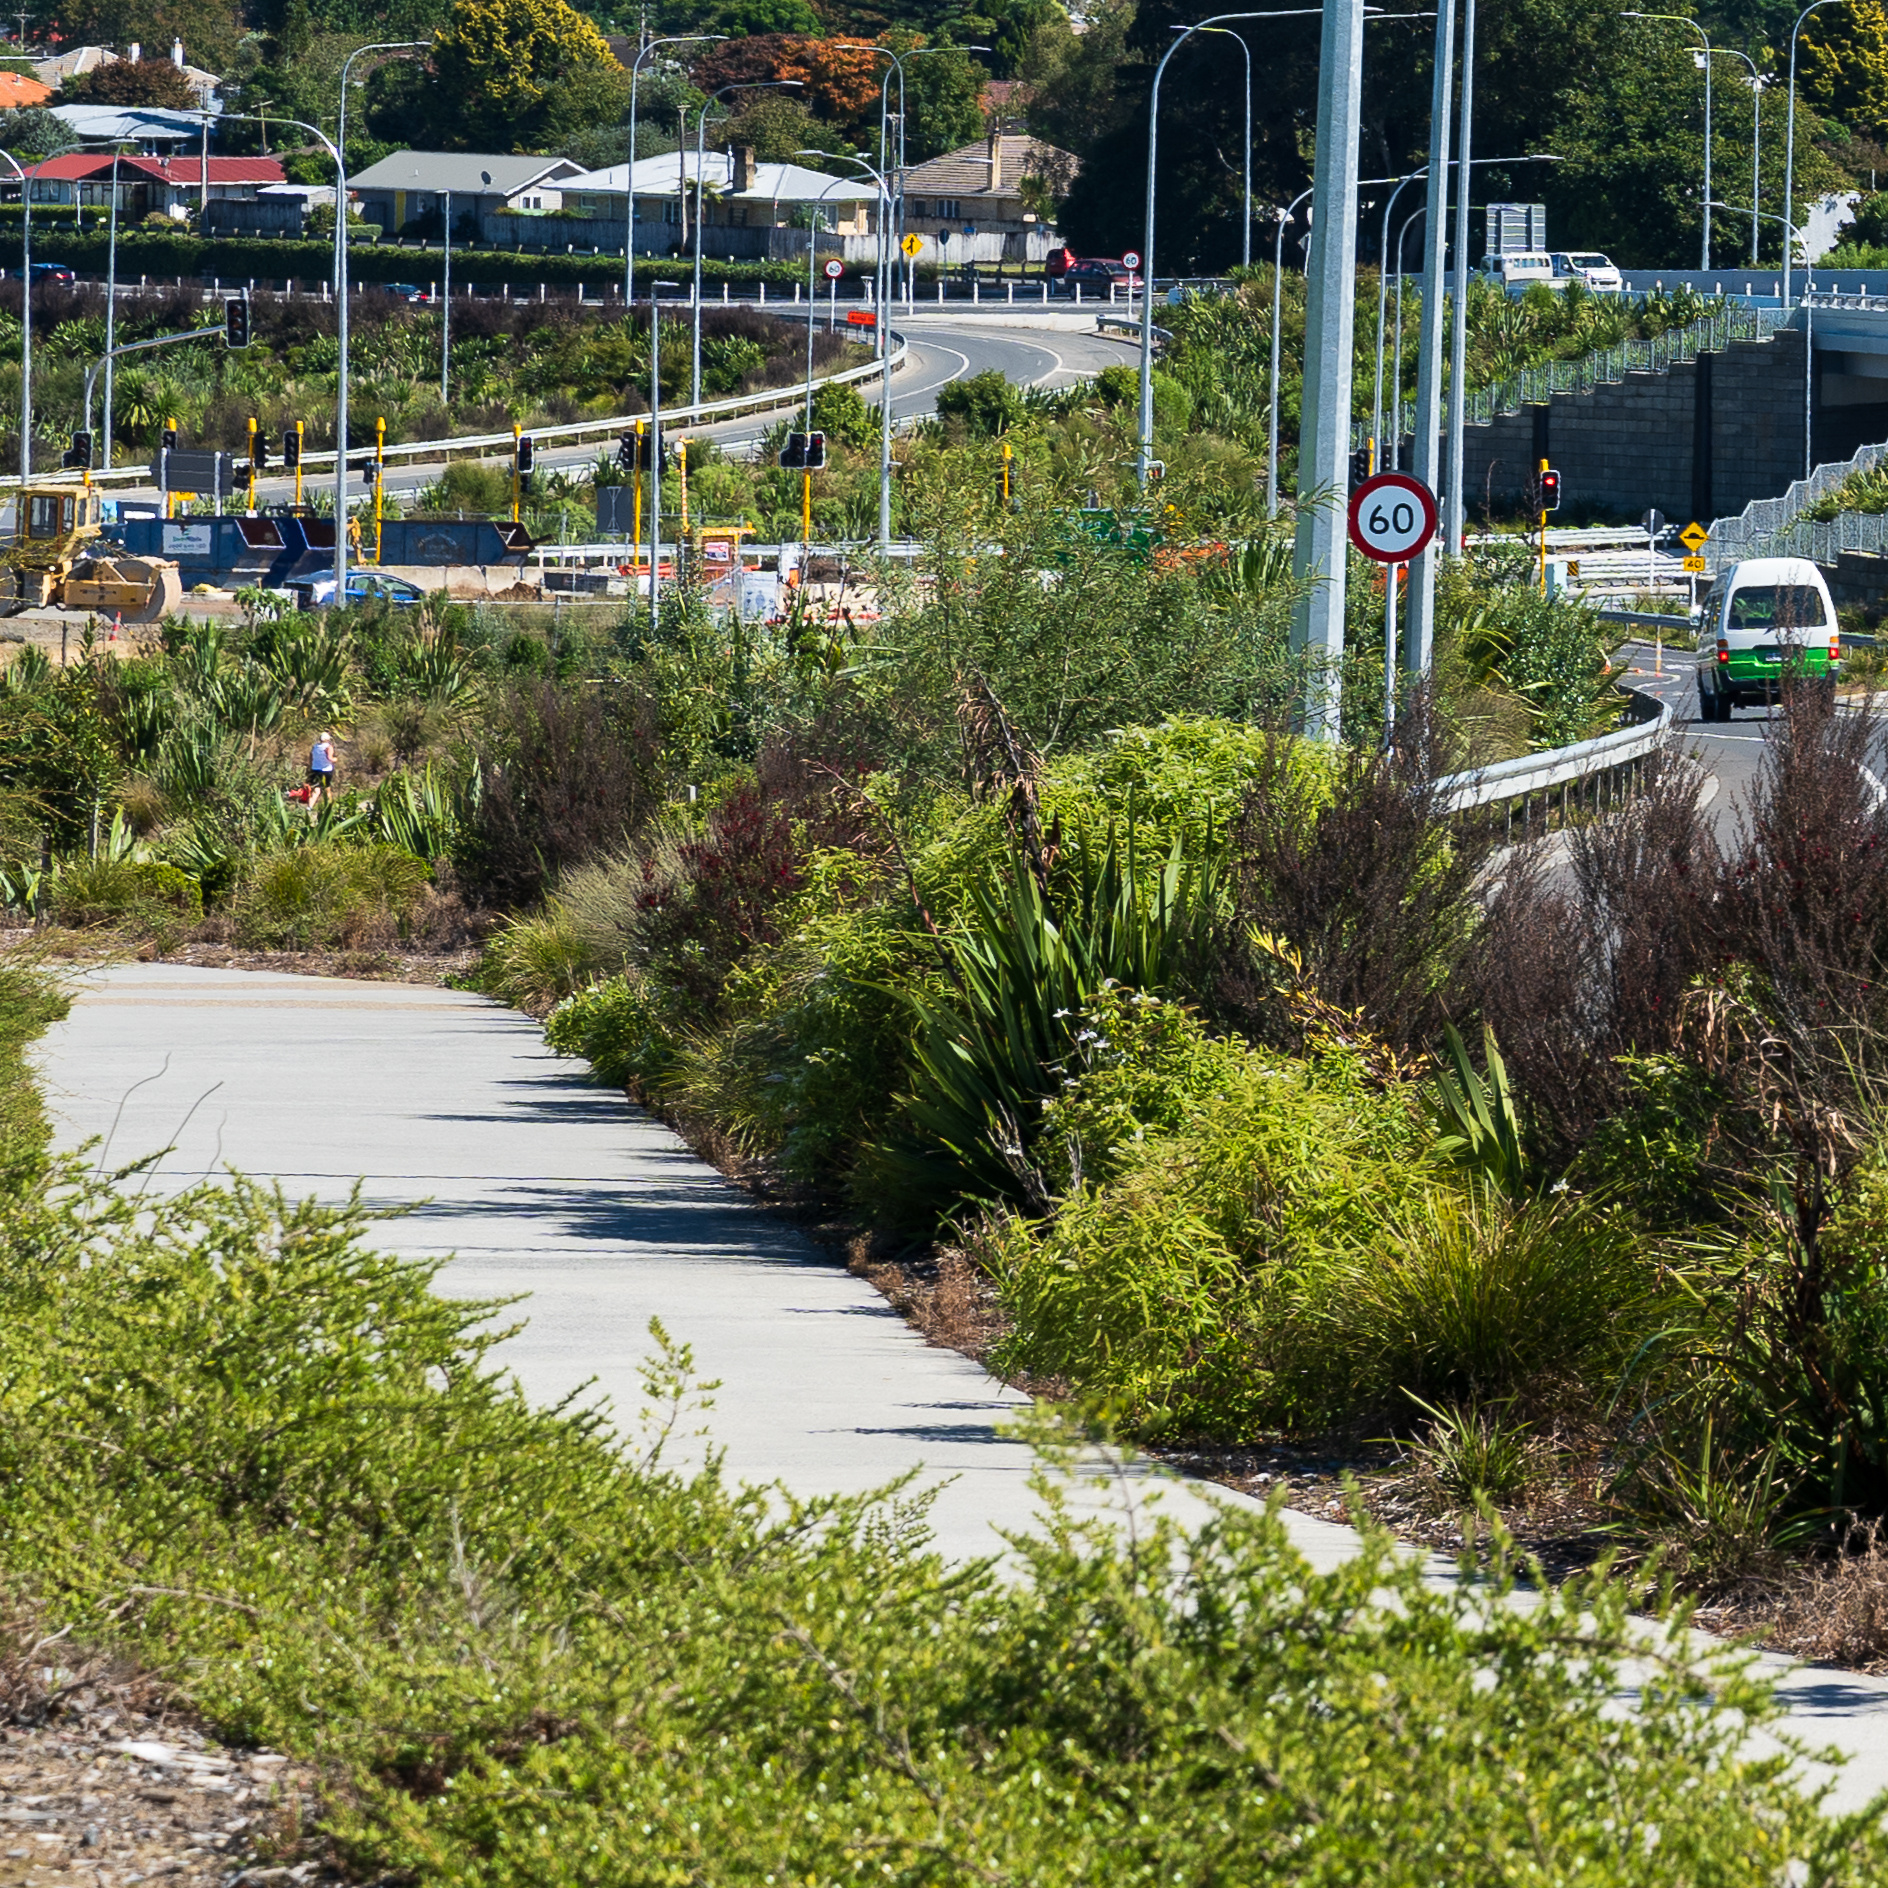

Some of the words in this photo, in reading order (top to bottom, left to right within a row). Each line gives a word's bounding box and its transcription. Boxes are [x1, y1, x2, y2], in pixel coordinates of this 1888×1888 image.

[1126, 256, 1137, 265] 60
[829, 264, 840, 273] 60
[1368, 502, 1414, 534] 60
